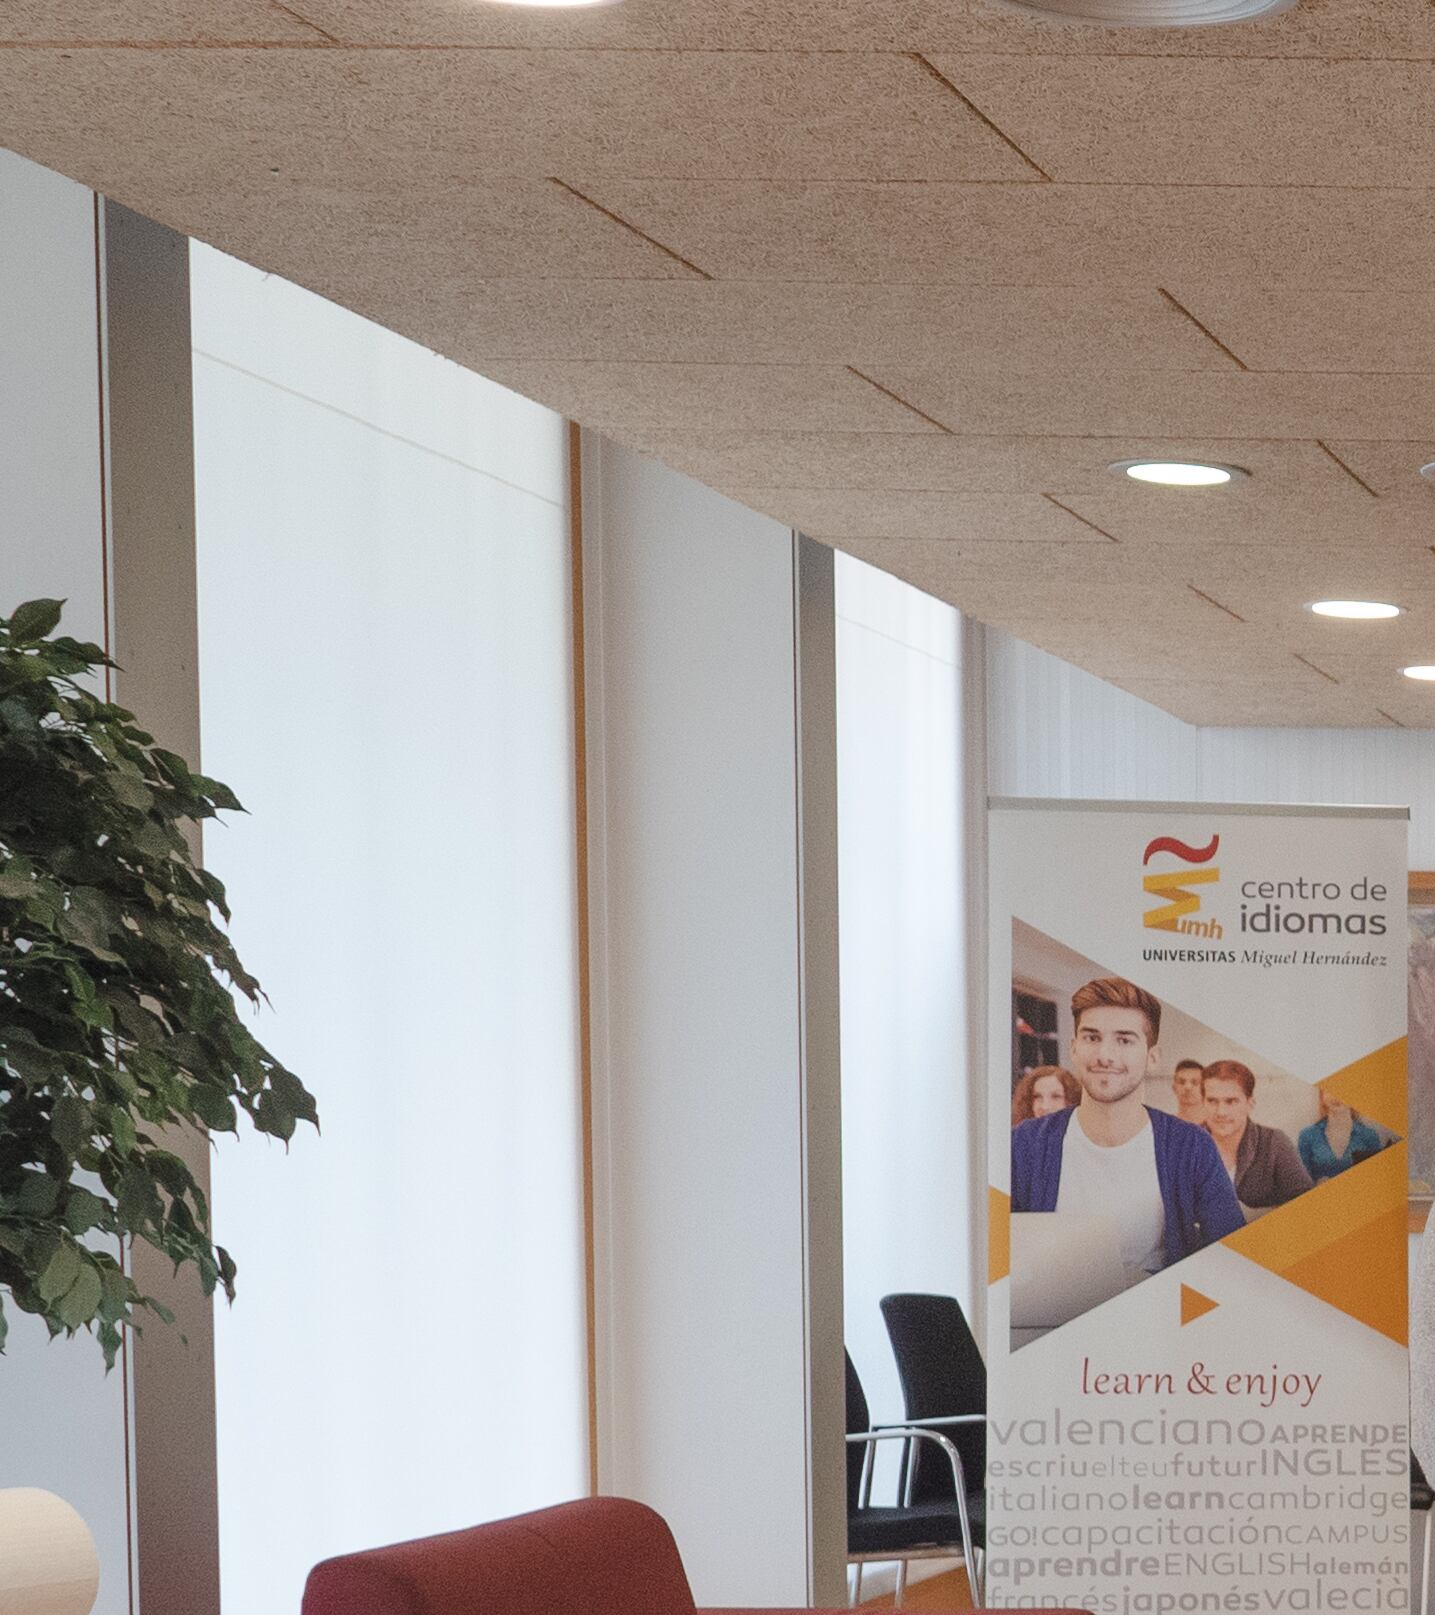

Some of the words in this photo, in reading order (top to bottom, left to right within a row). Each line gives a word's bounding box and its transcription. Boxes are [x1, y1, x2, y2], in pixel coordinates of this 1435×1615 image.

[1241, 876, 1341, 900] centro
[1350, 876, 1387, 901] de
[1240, 904, 1388, 935] idiomas
[1142, 949, 1236, 963] UNIVERSITAS
[1241, 950, 1297, 969] Miguel
[1302, 950, 1388, 967] Hernández
[1082, 1357, 1176, 1396] learn
[1186, 1361, 1216, 1396] &
[1225, 1364, 1323, 1408] enjoy
[990, 1408, 1266, 1446] valenciano
[1269, 1424, 1408, 1445] APRENDE
[1260, 1438, 1409, 1477] INGLÉS
[989, 1485, 1129, 1511] italiano
[1132, 1484, 1225, 1510] learn
[1228, 1484, 1409, 1518] cambridge
[1040, 1516, 1283, 1555] capacitación
[1285, 1524, 1409, 1545] CAMPUS
[988, 1550, 1161, 1586] aprendre
[1164, 1551, 1312, 1576] ENGLISH
[1312, 1555, 1409, 1576] alemán
